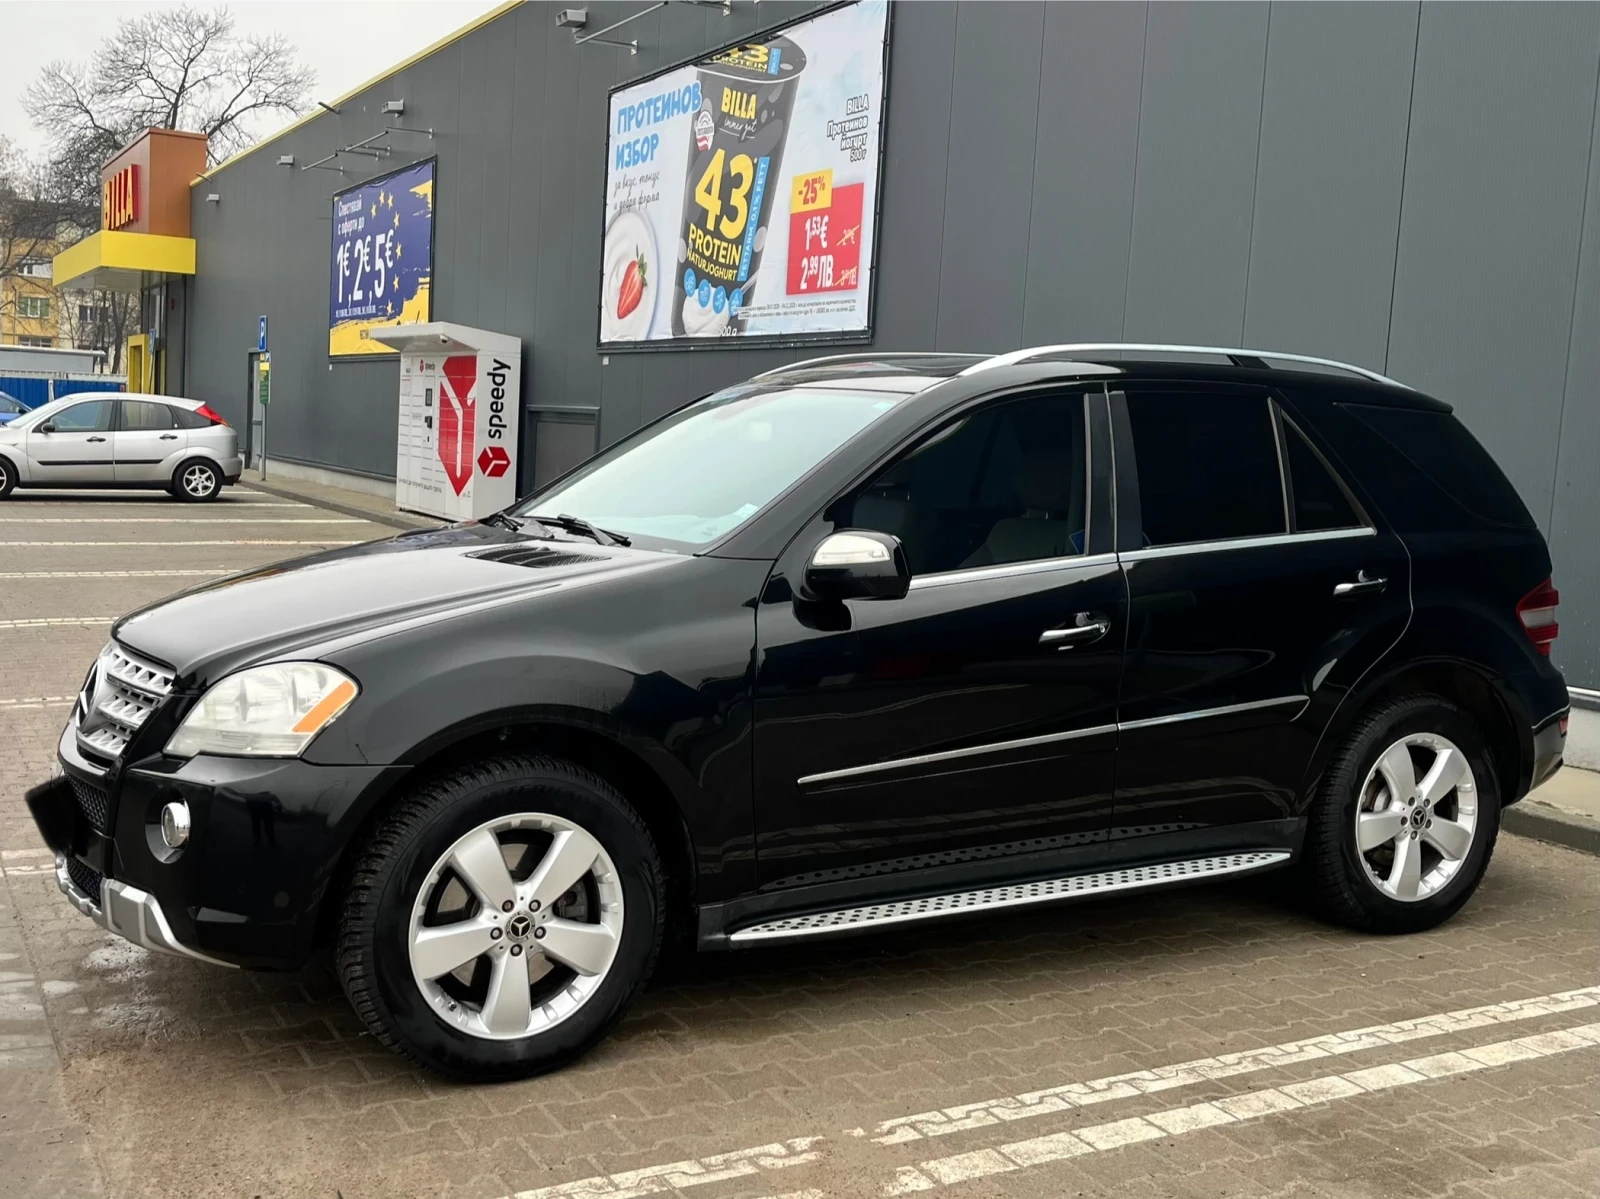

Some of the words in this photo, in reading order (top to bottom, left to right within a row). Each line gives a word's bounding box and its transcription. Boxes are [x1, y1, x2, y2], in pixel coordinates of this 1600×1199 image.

[617, 82, 701, 134] ПРОТЕИНОВ
[721, 87, 757, 119] BILLA
[846, 94, 869, 116] BILLA
[741, 118, 758, 141] gut
[827, 115, 868, 140] Протеинов
[841, 133, 868, 151] йогурт
[616, 133, 659, 171] ИЗБОР
[850, 149, 861, 162] 500
[104, 164, 137, 231] BILLA
[798, 175, 826, 205] -25%
[689, 223, 741, 266] PROTEIN
[687, 249, 738, 281] NATURJOGHURT
[260, 321, 265, 346] P
[488, 358, 511, 439] speedy
